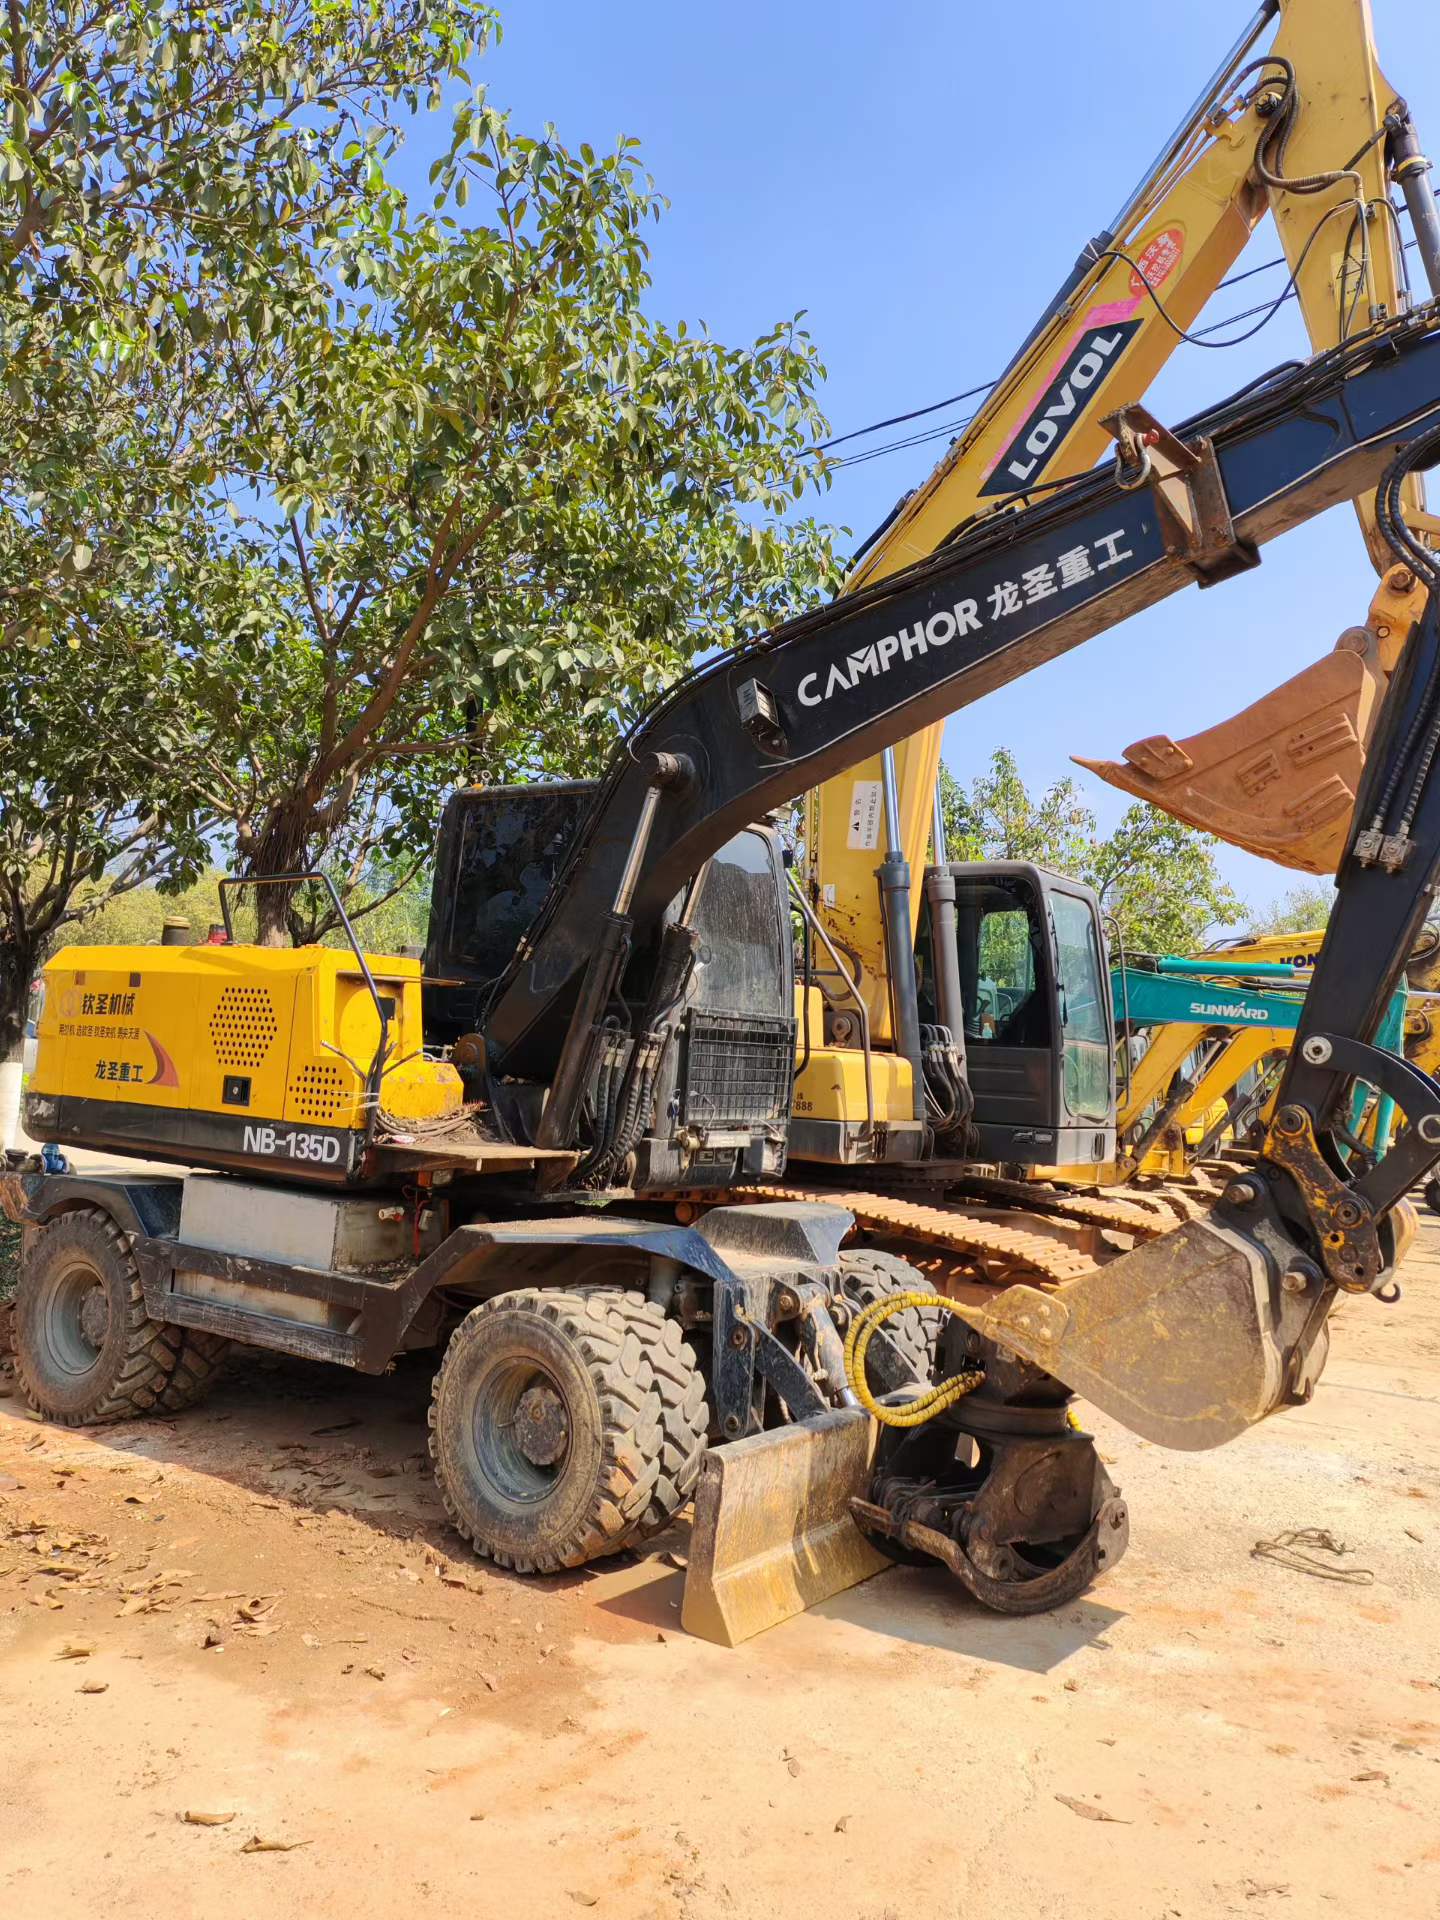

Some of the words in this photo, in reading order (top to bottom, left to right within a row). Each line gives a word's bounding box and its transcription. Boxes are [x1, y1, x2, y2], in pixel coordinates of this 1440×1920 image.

[1008, 332, 1123, 481] LOVOL
[797, 598, 983, 706] CAMPHOR
[987, 528, 1133, 620] 龙圣重工
[1189, 1001, 1269, 1020] SUNWARD
[95, 1060, 144, 1083] 龙圣重工
[243, 1125, 340, 1163] NB-135D
